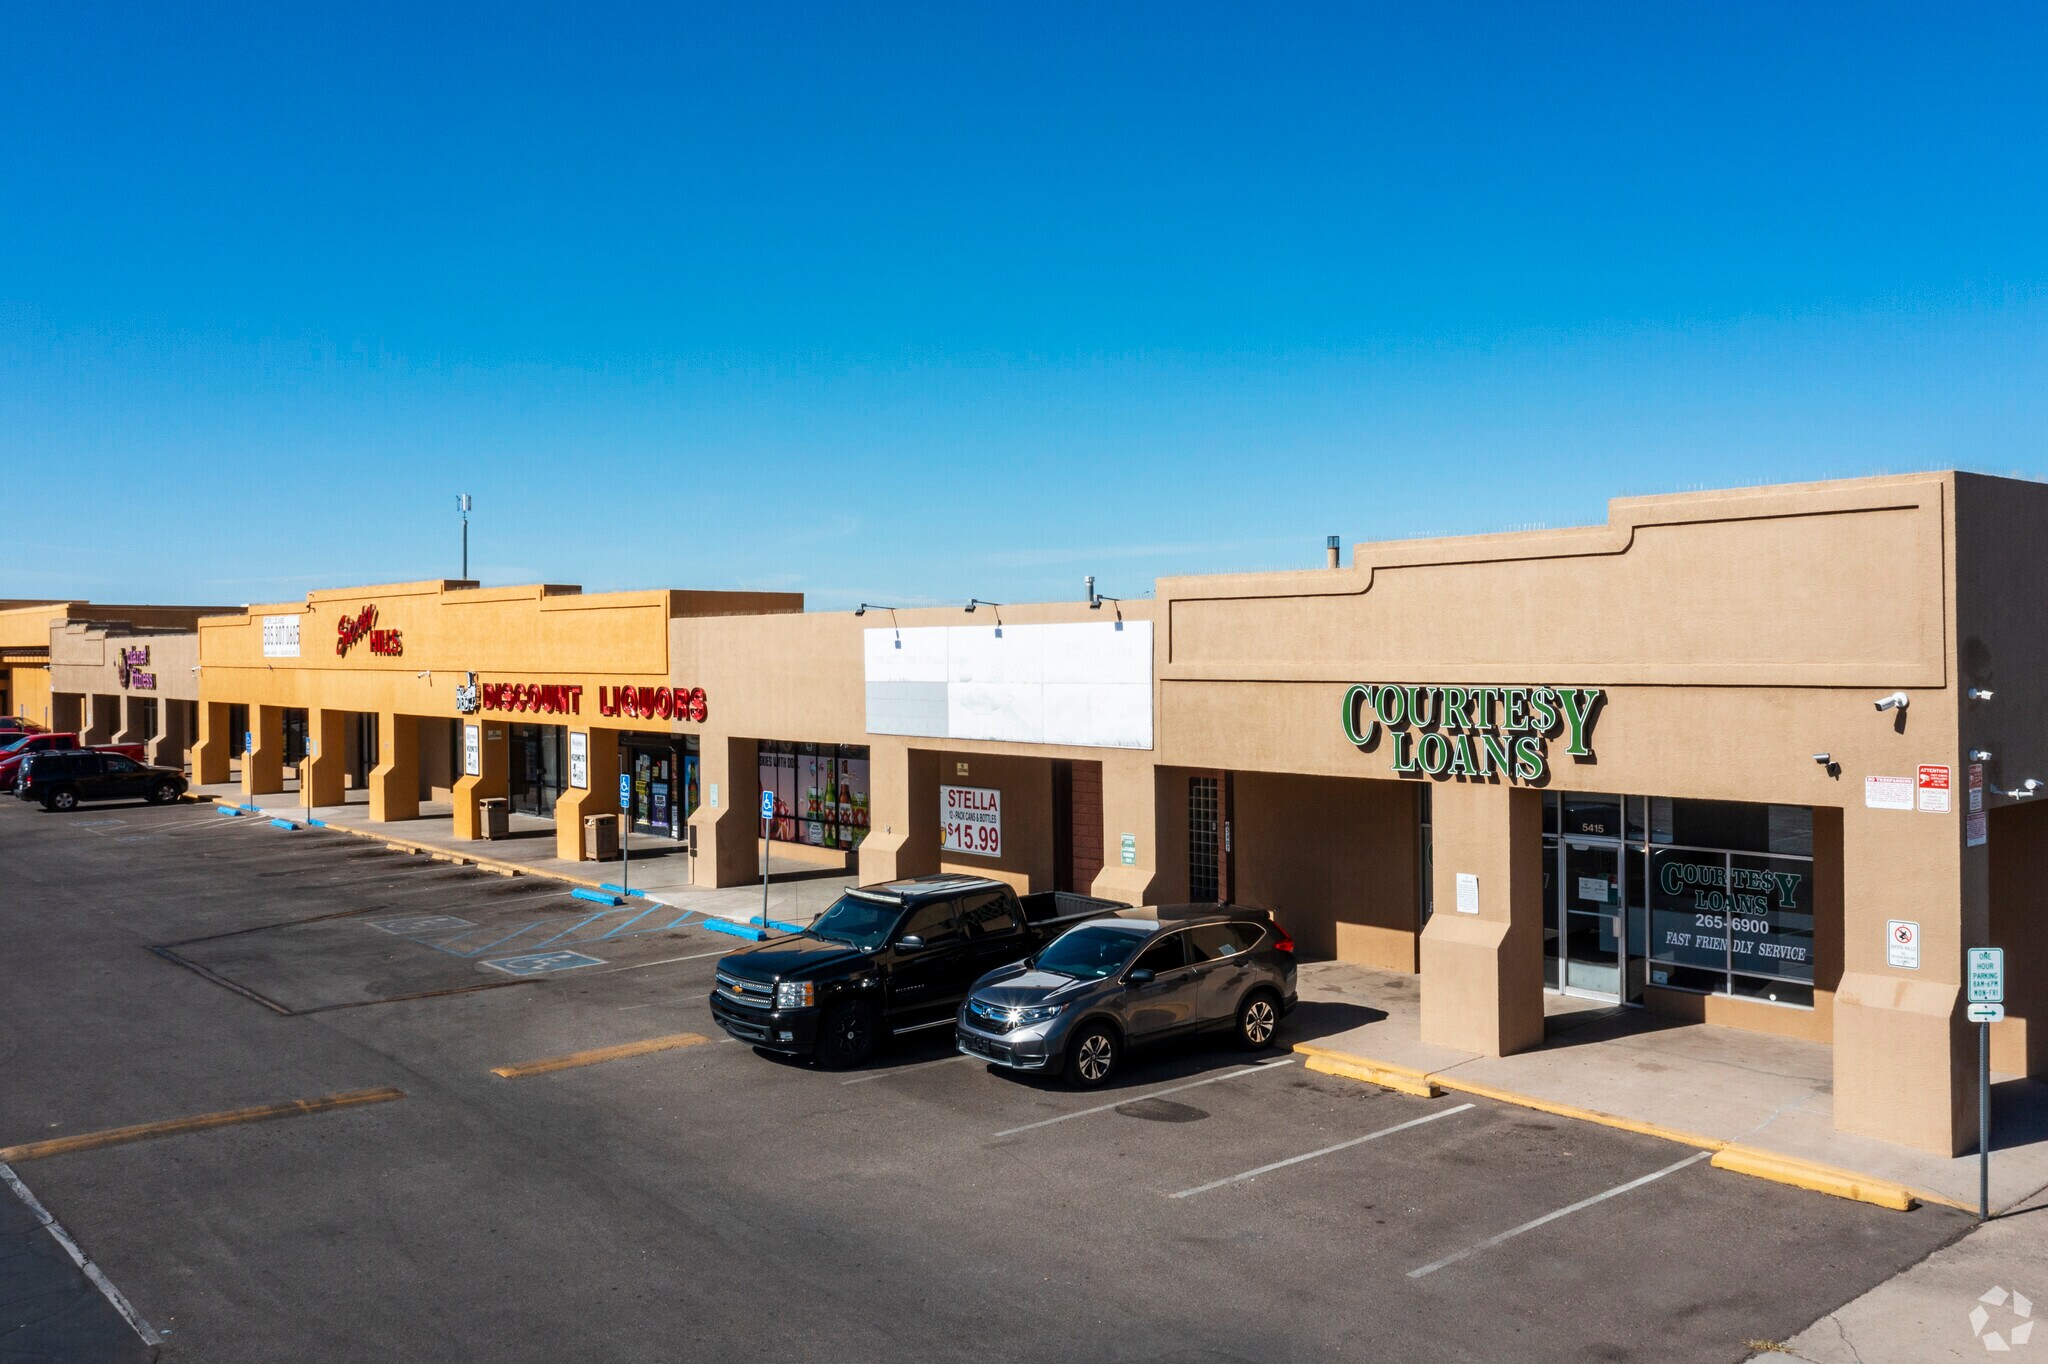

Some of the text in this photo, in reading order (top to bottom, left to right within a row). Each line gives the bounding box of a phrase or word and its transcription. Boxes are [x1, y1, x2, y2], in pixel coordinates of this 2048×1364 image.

[127, 649, 147, 670] planet
[132, 668, 153, 688] fitness
[482, 682, 583, 715] DISCOUNT
[599, 685, 708, 722] LIQUORS
[1390, 731, 1544, 780] LOANS
[947, 789, 998, 811] STELLA
[965, 811, 976, 821] CANS
[947, 822, 999, 852] $15.99
[1582, 822, 1604, 834] 5415
[1695, 890, 1768, 916] LOANS
[1695, 913, 1769, 935] 265-6900
[1666, 931, 1807, 962] FAST FRIENDLY SERVICE
[1979, 952, 1992, 960] ONE
